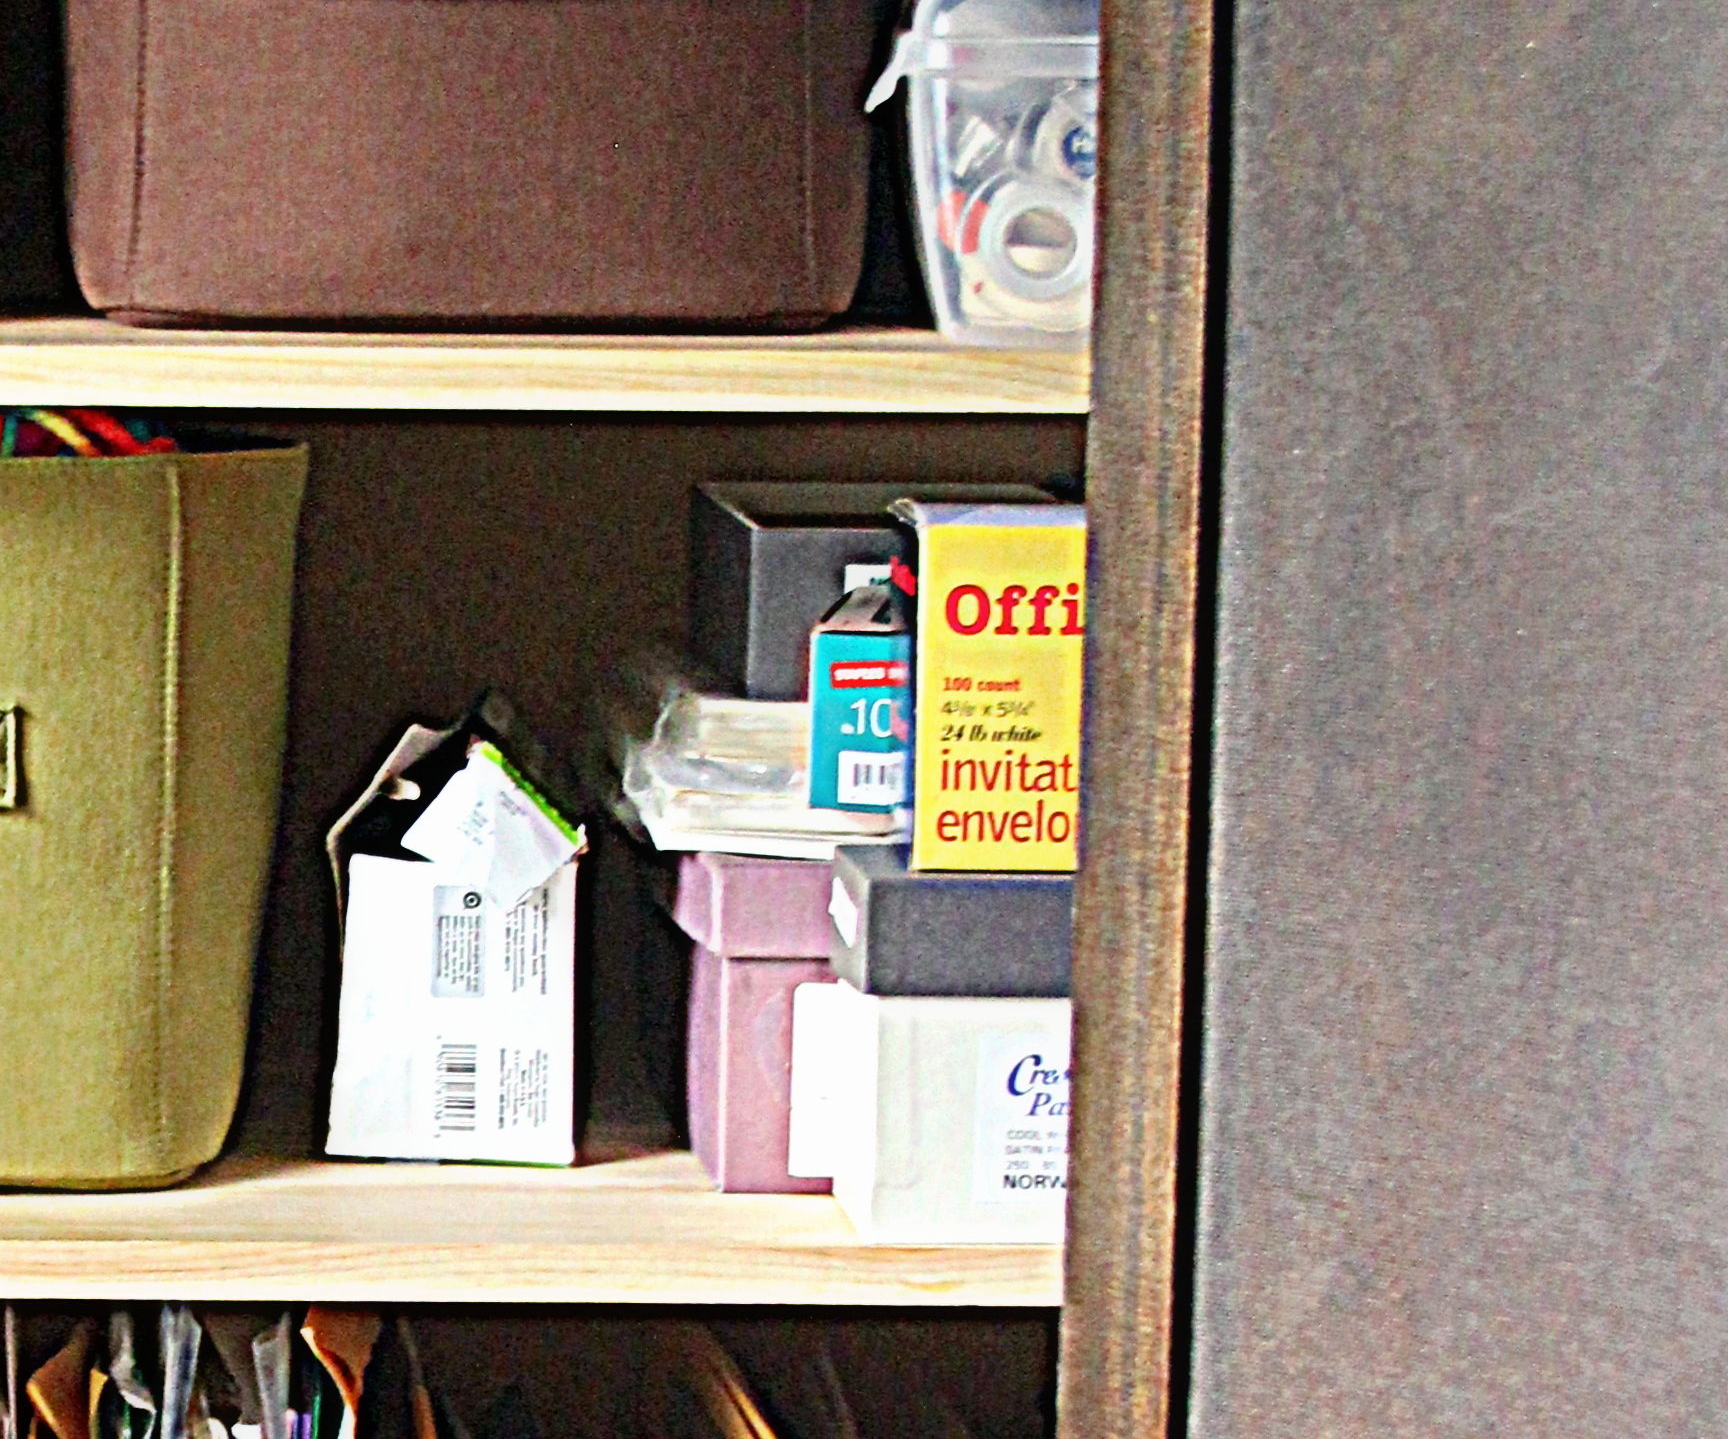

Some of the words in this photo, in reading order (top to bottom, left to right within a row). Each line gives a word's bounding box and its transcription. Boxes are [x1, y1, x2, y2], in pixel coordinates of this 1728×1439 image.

[945, 582, 1085, 636] Offi
[943, 677, 972, 691] 100
[977, 678, 1022, 692] count
[941, 724, 966, 741] 24
[969, 724, 988, 741] lb
[991, 725, 1043, 741] white
